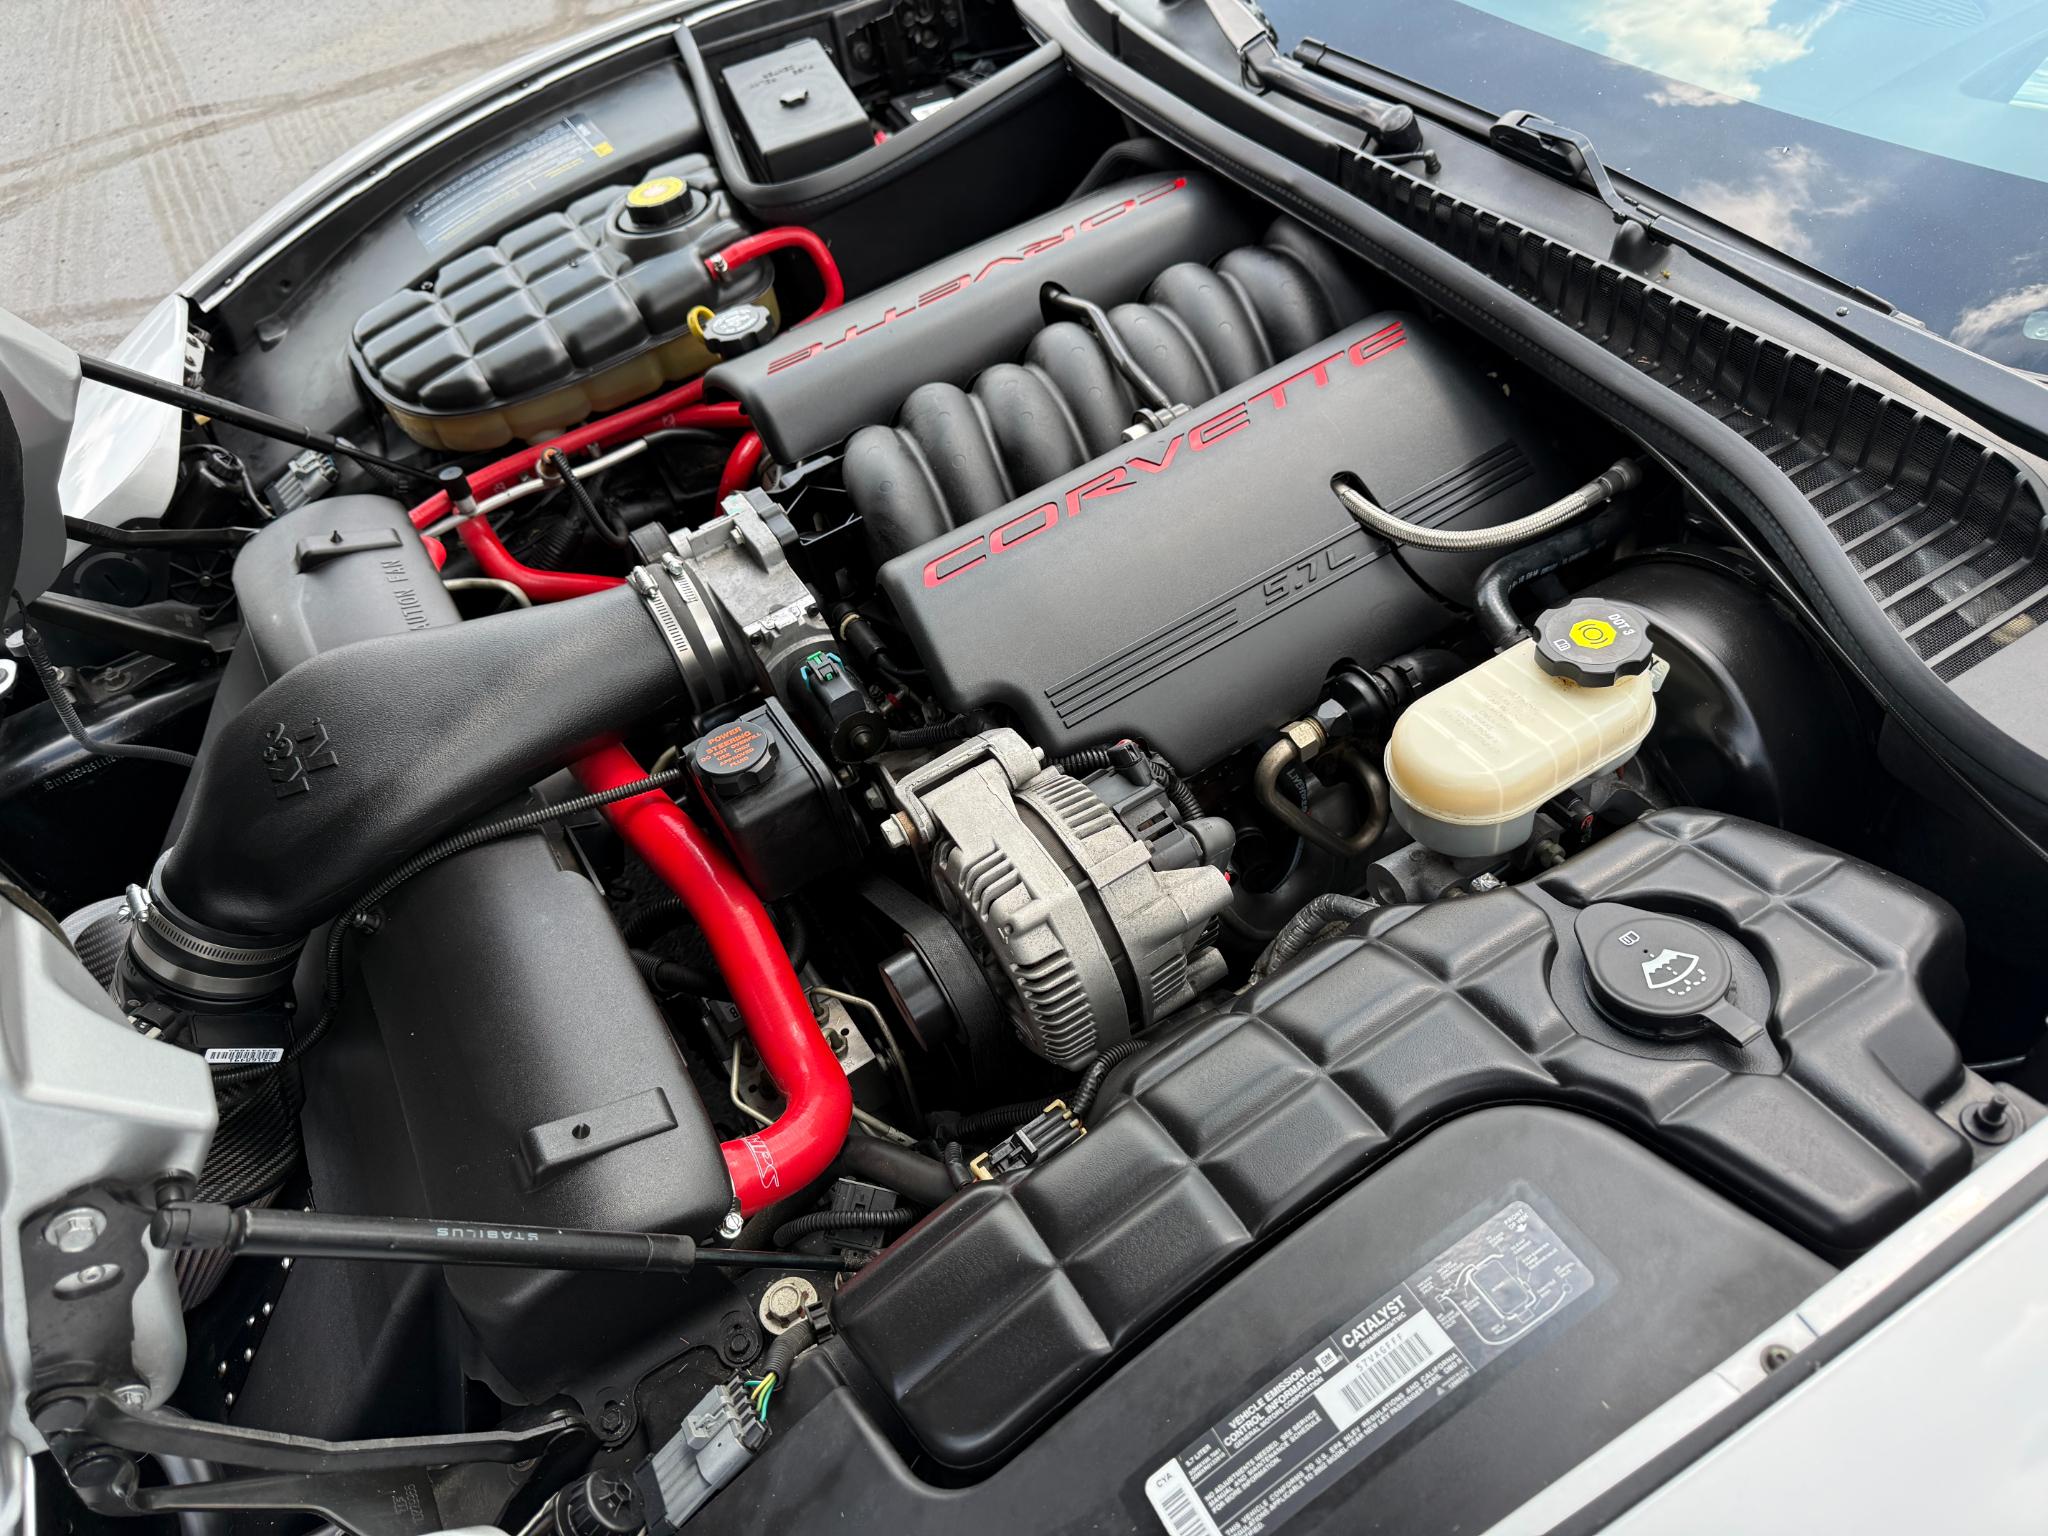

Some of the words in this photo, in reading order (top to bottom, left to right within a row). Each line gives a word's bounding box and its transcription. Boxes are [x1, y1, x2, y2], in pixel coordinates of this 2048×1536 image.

[768, 178, 1188, 376] CORVETTE
[923, 320, 1408, 588] CORVETTE
[380, 560, 409, 583] FAN
[1263, 548, 1356, 606] 5.7L
[394, 589, 430, 632] AUTION
[1608, 613, 1630, 629] DOT
[700, 755, 712, 763] DO
[713, 748, 728, 757] NOT
[730, 732, 762, 749] OVERFILL
[705, 731, 752, 754] STEERING
[707, 726, 742, 745] POWER
[717, 753, 732, 761] USE
[733, 744, 751, 753] ONLY
[719, 748, 755, 766] APPROVED
[729, 756, 750, 768] FLUID
[437, 1227, 538, 1240] STABILUS
[1340, 1294, 1408, 1350] CATALYST
[1221, 1410, 1265, 1447] CONTROL
[1263, 1366, 1322, 1414] INFORMATION
[1227, 1397, 1266, 1430] VEHICLE
[1262, 1366, 1305, 1402] EMISSION
[1232, 1425, 1261, 1449] GENERAL
[1259, 1406, 1285, 1428] MOTORS
[1282, 1375, 1324, 1410] CORPORATION
[1192, 1442, 1212, 1461] LITER
[1203, 1490, 1215, 1501] NO
[1212, 1458, 1255, 1494] ADJUSTMENTS
[1253, 1439, 1279, 1461] NEEDED.
[1278, 1428, 1293, 1441] SEE
[1291, 1408, 1317, 1432] SERVICE
[1206, 1484, 1234, 1507] MANUAL
[1231, 1472, 1248, 1487] AND
[1245, 1439, 1290, 1477] MAINTENANCE
[1288, 1414, 1322, 1443] SCHEDULE
[1240, 1498, 1269, 1524] VEHICLE
[1267, 1470, 1305, 1502] CONFORMS
[1303, 1461, 1315, 1473] TO
[1360, 1391, 1405, 1428] REGULATIONS
[1404, 1379, 1420, 1394] AND
[1418, 1351, 1458, 1383] CALIFORNIA
[1268, 1479, 1306, 1511] APPLICABLE
[1304, 1472, 1314, 1482] TO
[1363, 1421, 1379, 1436] NEW
[1388, 1385, 1425, 1415] PASSENGER
[1154, 1471, 1173, 1488] CYA
[1210, 1499, 1226, 1514] FOR
[1223, 1486, 1242, 1503] MORE
[1240, 1455, 1281, 1490] INFORMATION.
